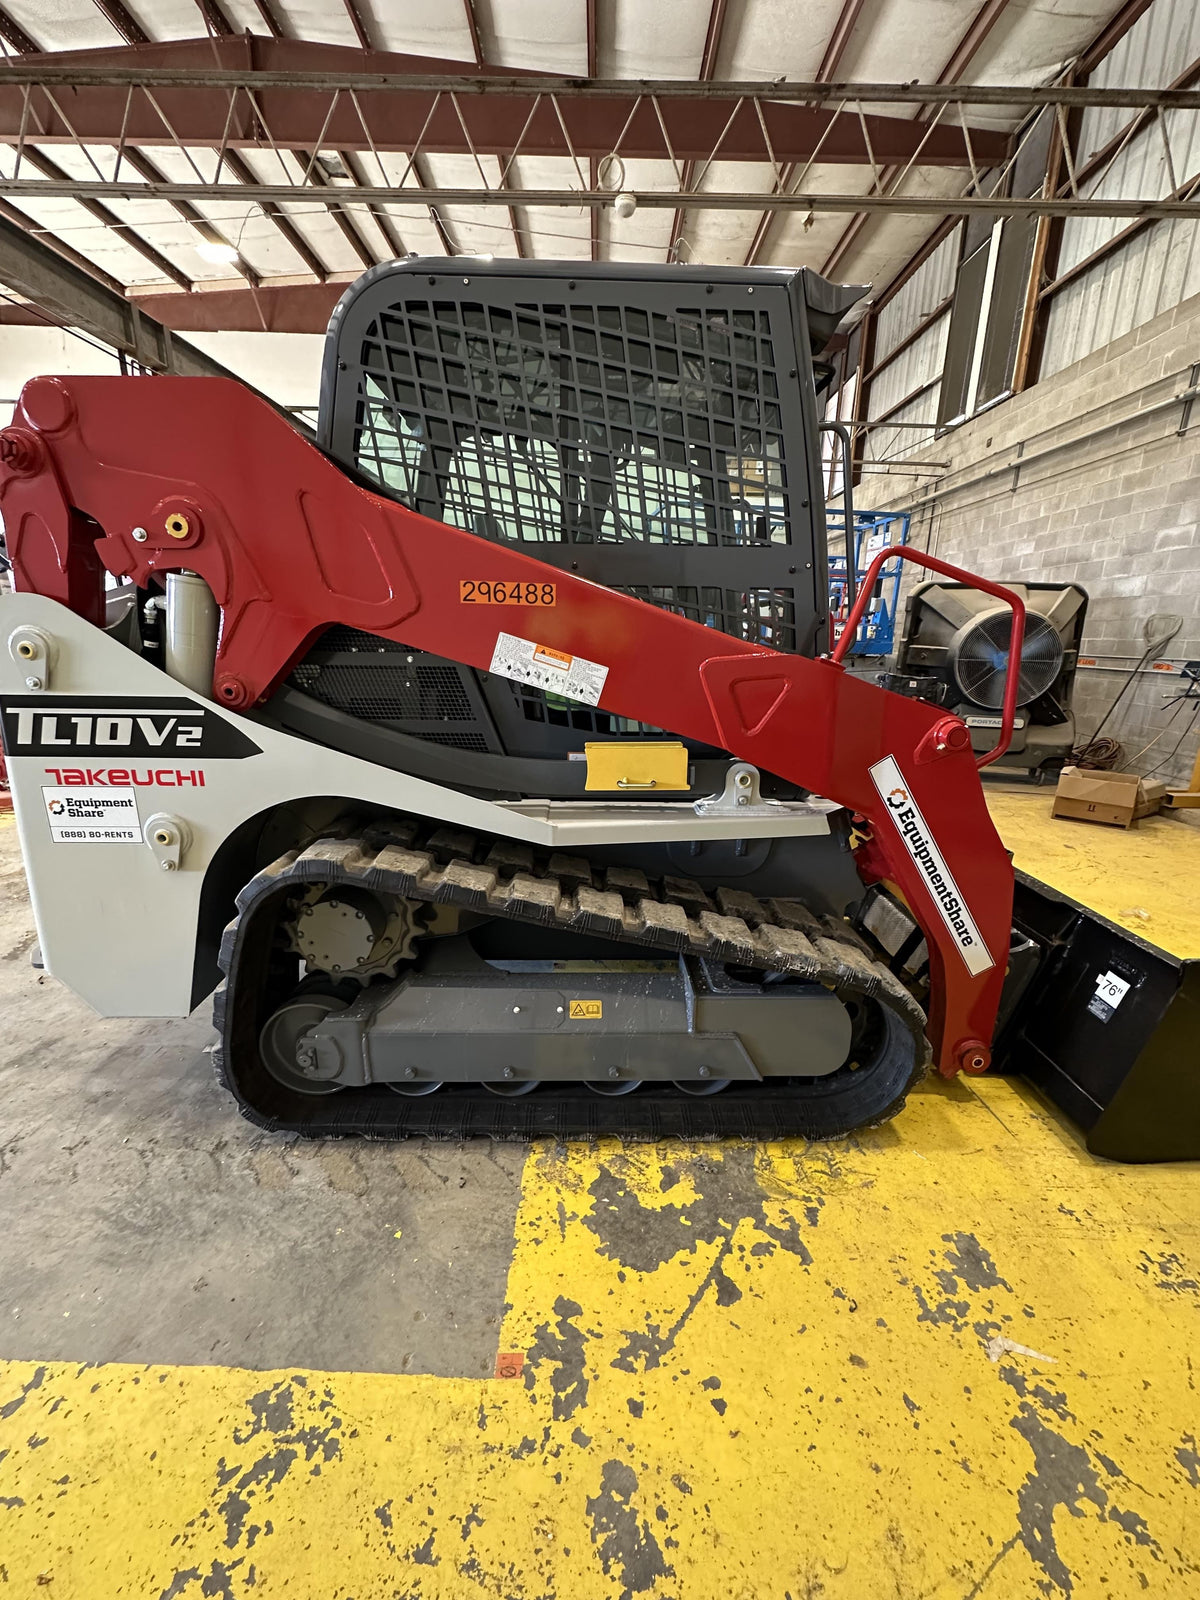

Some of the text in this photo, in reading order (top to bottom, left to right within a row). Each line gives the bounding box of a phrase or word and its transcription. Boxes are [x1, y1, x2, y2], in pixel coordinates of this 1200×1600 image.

[462, 581, 554, 605] 296488
[6, 707, 205, 747] TL10V2
[65, 797, 134, 809] Equipment
[67, 808, 104, 818] Share
[60, 830, 134, 839] (888) 80-RENTS
[898, 807, 974, 947] EquipmentShare
